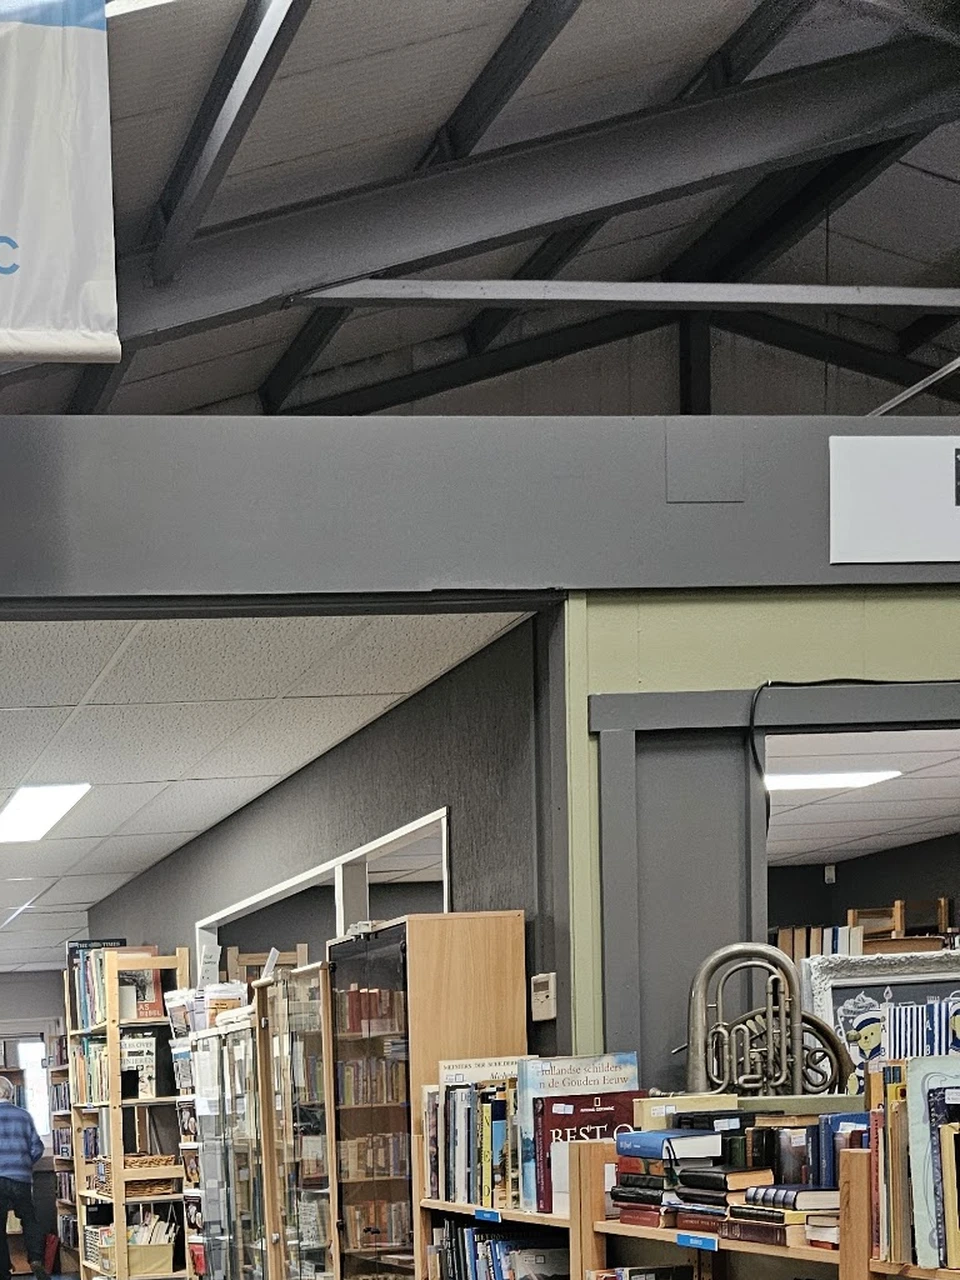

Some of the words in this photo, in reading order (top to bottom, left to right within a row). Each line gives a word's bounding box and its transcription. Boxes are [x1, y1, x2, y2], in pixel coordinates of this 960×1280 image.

[583, 1062, 622, 1074] schilders
[548, 1079, 559, 1088] de
[562, 1077, 600, 1087] Gouden
[602, 1075, 629, 1085] Eeuw
[550, 1124, 608, 1143] BEST
